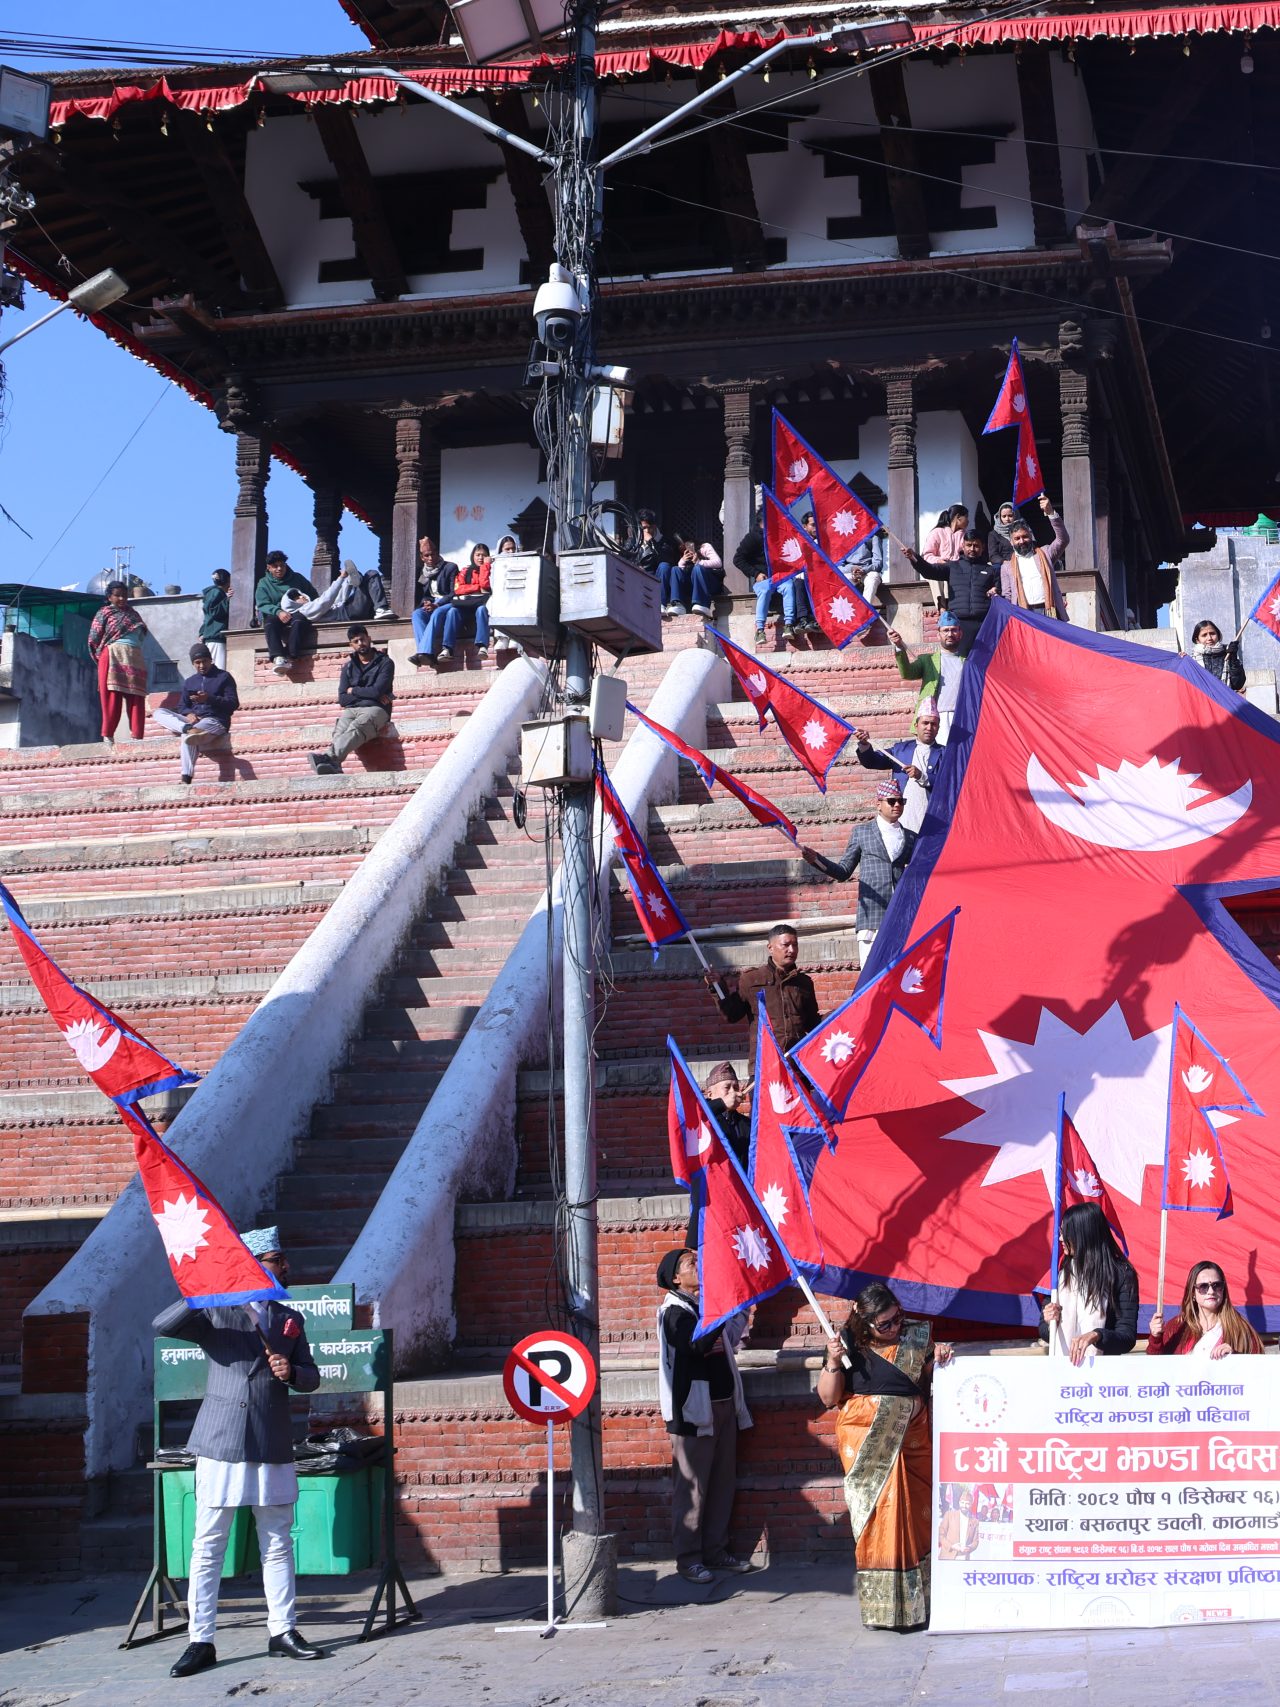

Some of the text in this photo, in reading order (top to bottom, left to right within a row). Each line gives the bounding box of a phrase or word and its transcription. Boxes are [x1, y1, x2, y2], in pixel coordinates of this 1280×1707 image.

[1060, 1382, 1093, 1399] हाम्रो
[1137, 1382, 1170, 1398] हाम्रो
[1175, 1380, 1244, 1397] स्वाभिमान
[1055, 1408, 1104, 1427] राष्ट्रिय
[1158, 1407, 1191, 1424] हाम्रो
[1197, 1406, 1250, 1423] पहिचान
[1018, 1437, 1108, 1480] राष्ट्रिय
[1077, 1493, 1119, 1506] २०८२
[1126, 1488, 1156, 1505] पौष
[1161, 1492, 1171, 1505] १
[1178, 1487, 1248, 1505] (डिसेम्बर
[1253, 1490, 1280, 1505] १६)
[1080, 1518, 1152, 1535] बसन्तपुर
[1046, 1568, 1100, 1589] राष्ट्रिय
[1105, 1568, 1159, 1587] धरोहर
[1164, 1569, 1222, 1586] संरक्षण
